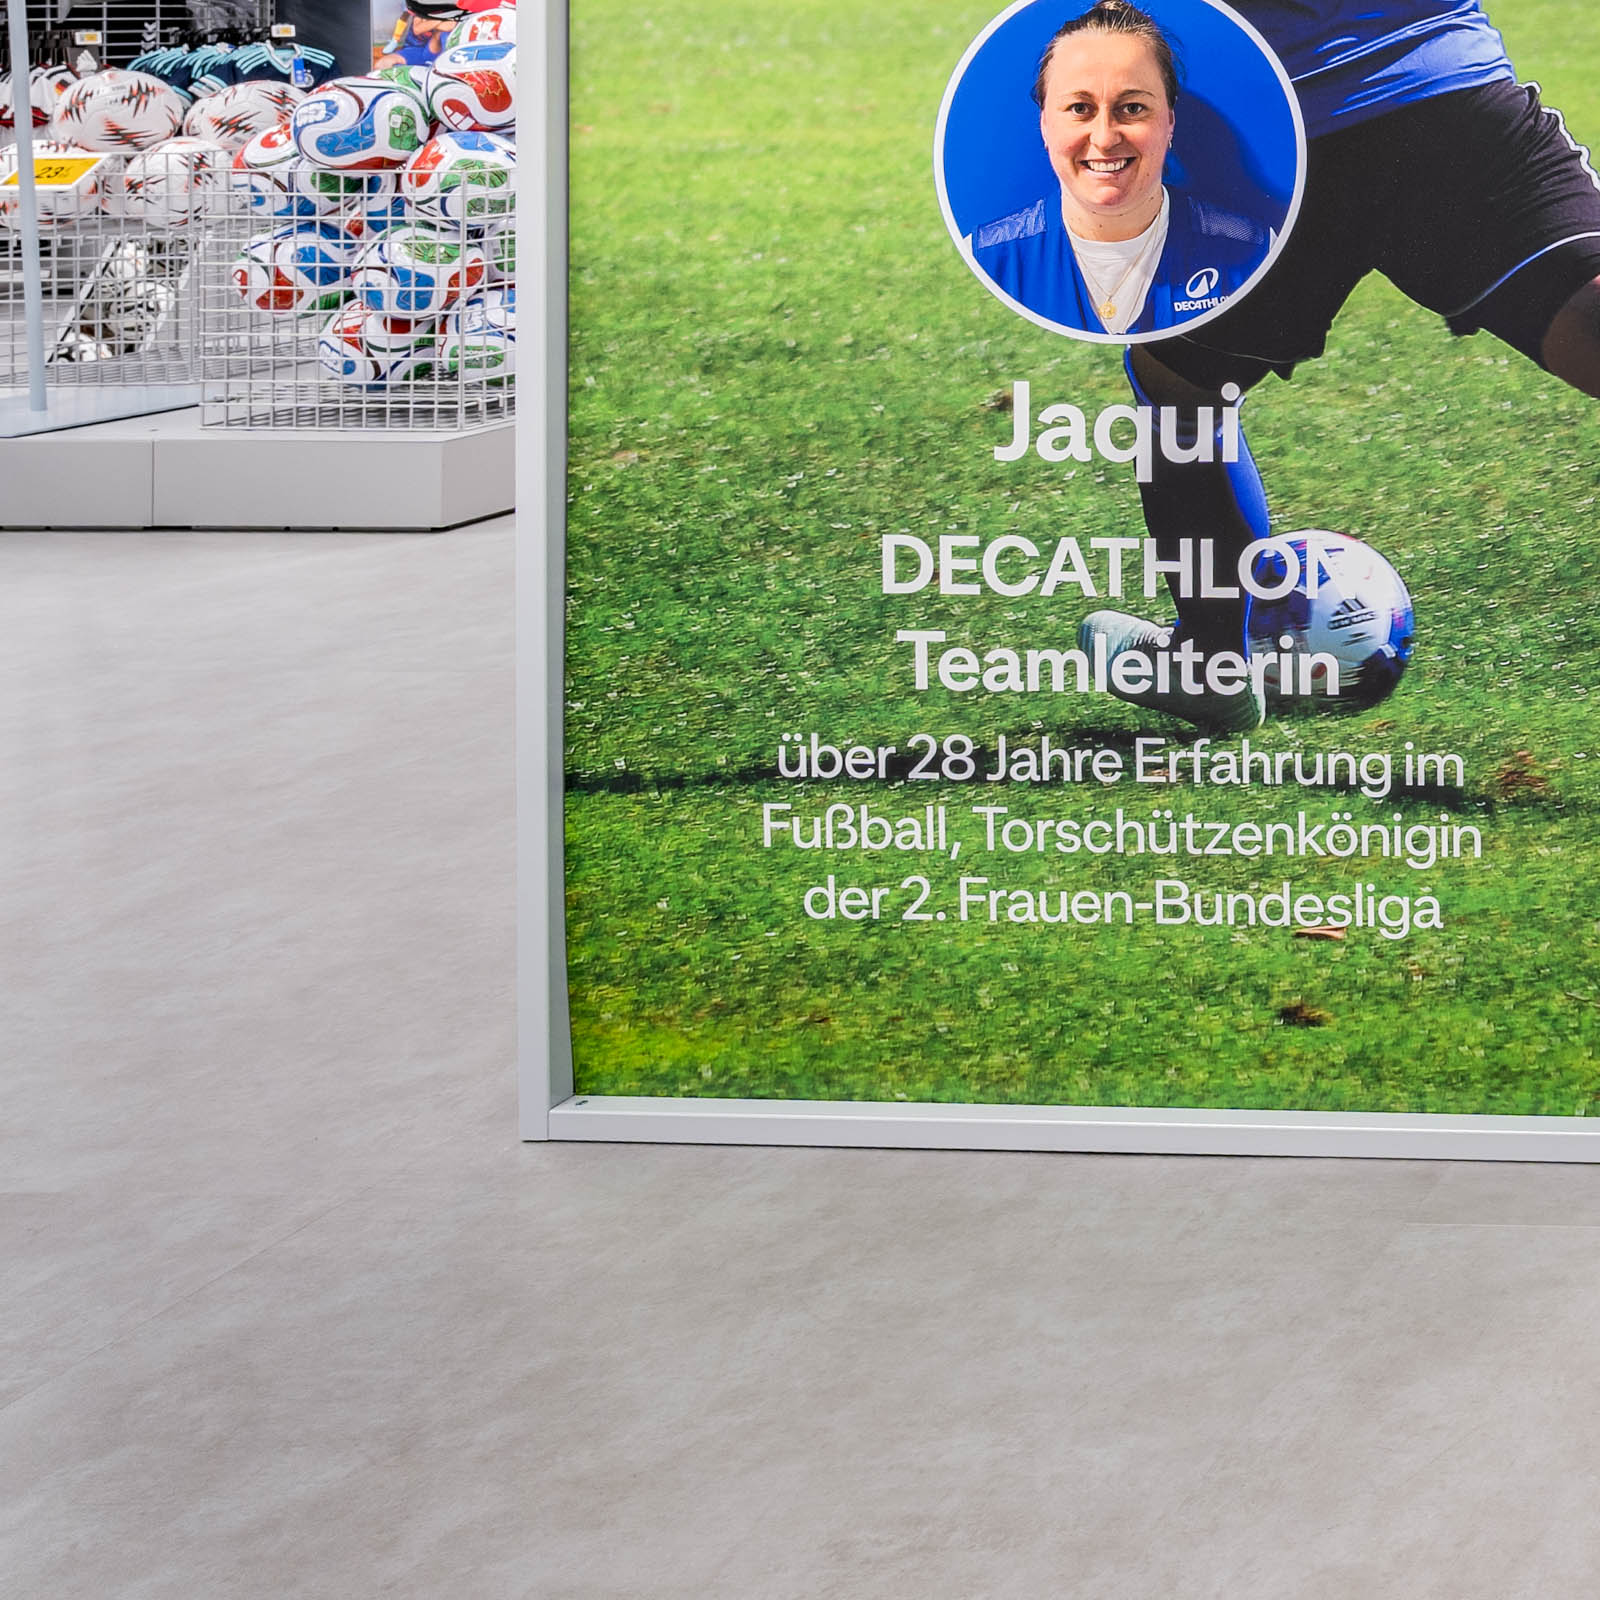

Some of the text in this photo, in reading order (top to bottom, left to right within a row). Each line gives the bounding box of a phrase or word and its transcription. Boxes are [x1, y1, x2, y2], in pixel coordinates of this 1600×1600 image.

[1173, 295, 1231, 312] DECATHLO
[994, 381, 1240, 482] Jaqui
[882, 534, 1357, 600] DECATHLON
[897, 630, 1341, 696] Teamleiterin
[777, 734, 1464, 798] über 28 Jahre Erfahrung im
[763, 802, 1482, 870] Fußball, Torschützenkönigin
[804, 874, 1443, 940] der 2. Frauen-Bundesliga
